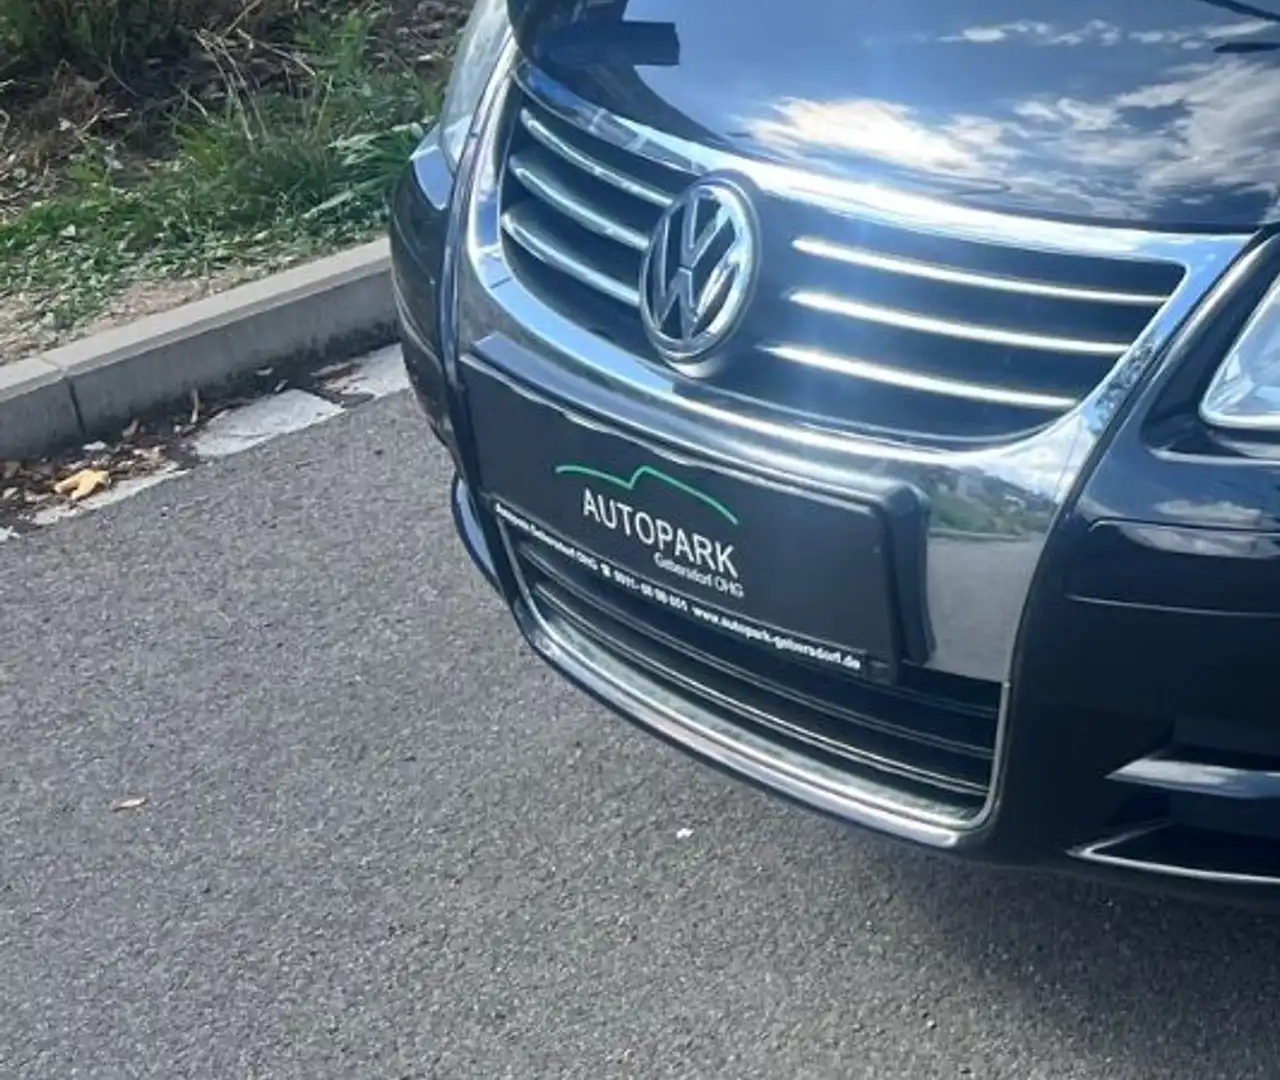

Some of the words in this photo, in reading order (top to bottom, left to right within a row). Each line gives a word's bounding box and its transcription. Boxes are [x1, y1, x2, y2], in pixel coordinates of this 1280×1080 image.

[583, 486, 739, 579] AUTOPARK
[653, 551, 713, 587] Gebersdorf
[713, 576, 745, 599] OHG
